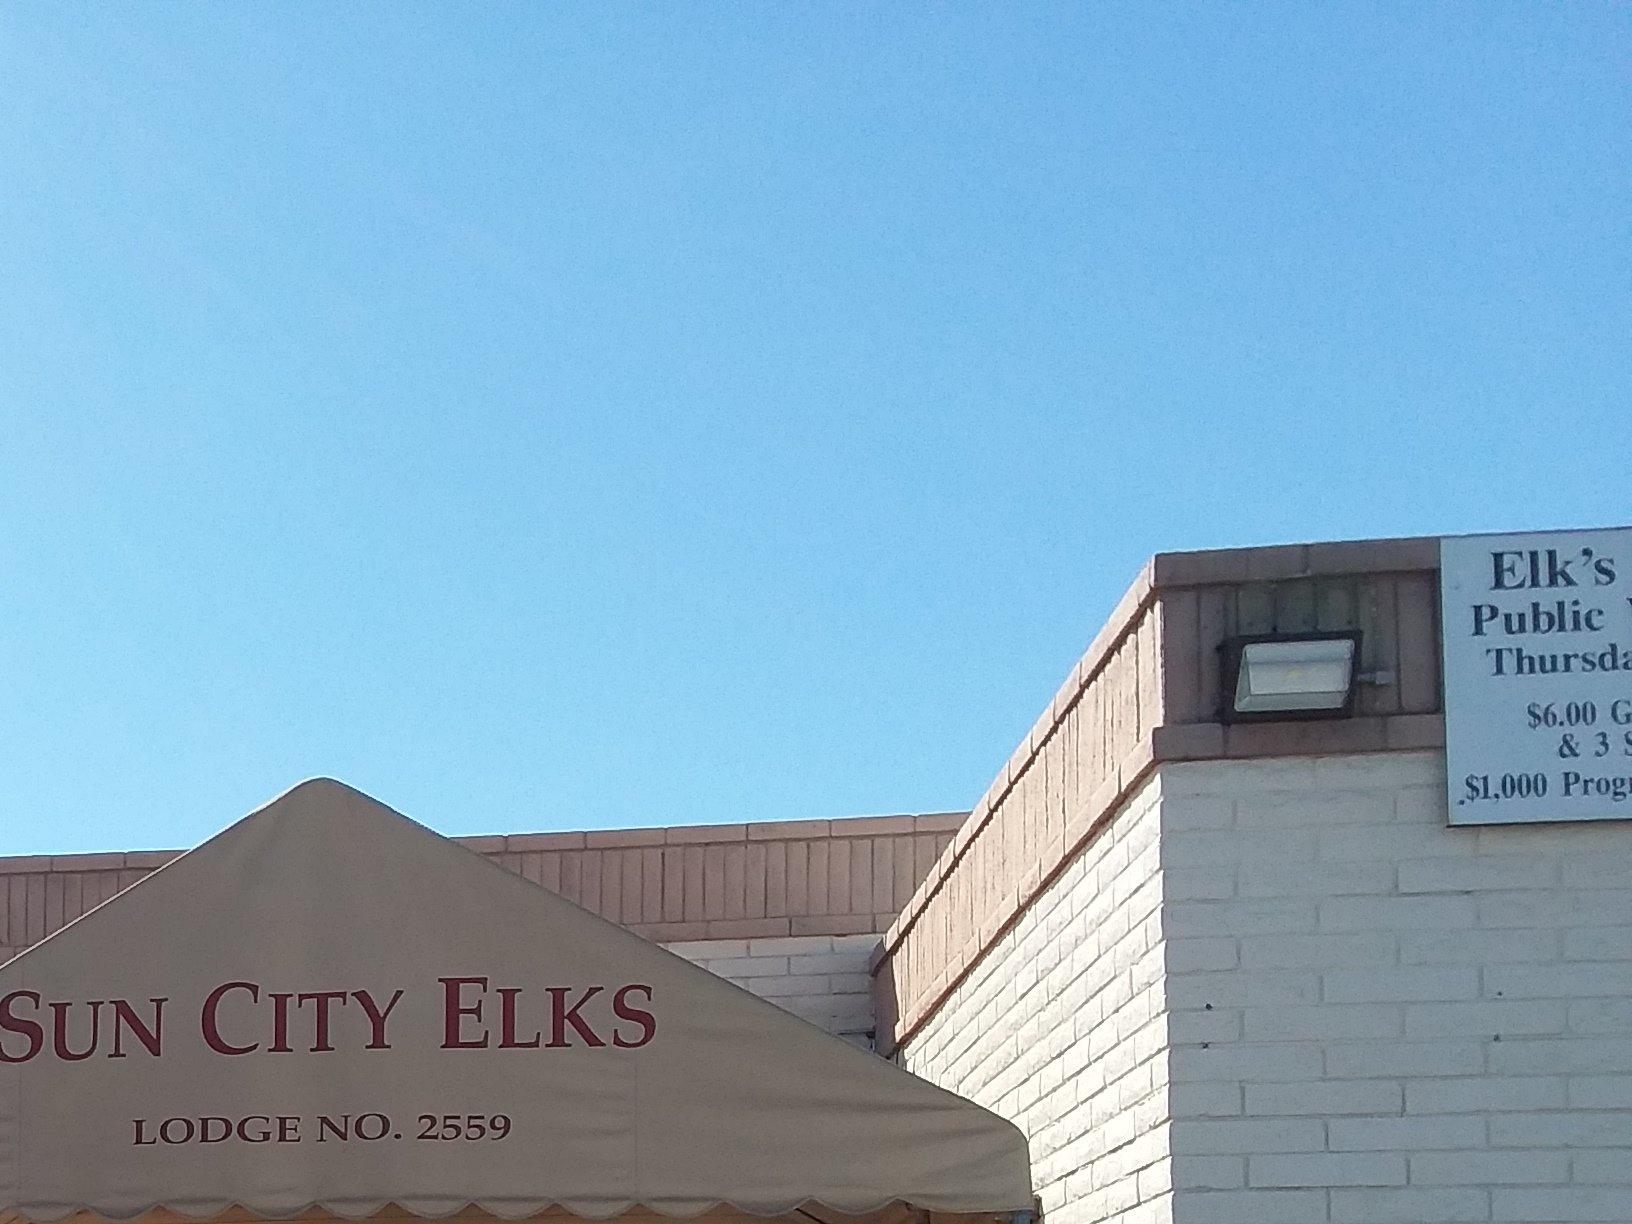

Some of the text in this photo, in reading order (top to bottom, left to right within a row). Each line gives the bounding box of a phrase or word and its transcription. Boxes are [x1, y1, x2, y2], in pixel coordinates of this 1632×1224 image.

[1489, 547, 1617, 590] Elk's
[1471, 599, 1605, 636] Public
[1527, 701, 1597, 729] $6.00
[1558, 732, 1581, 758] &
[1594, 731, 1610, 757] 3
[1465, 771, 1632, 802] $1,000 Prog
[201, 981, 404, 1056] CITY
[438, 976, 656, 1049] ELKS
[132, 1113, 512, 1145] LODGE NO. 2559
